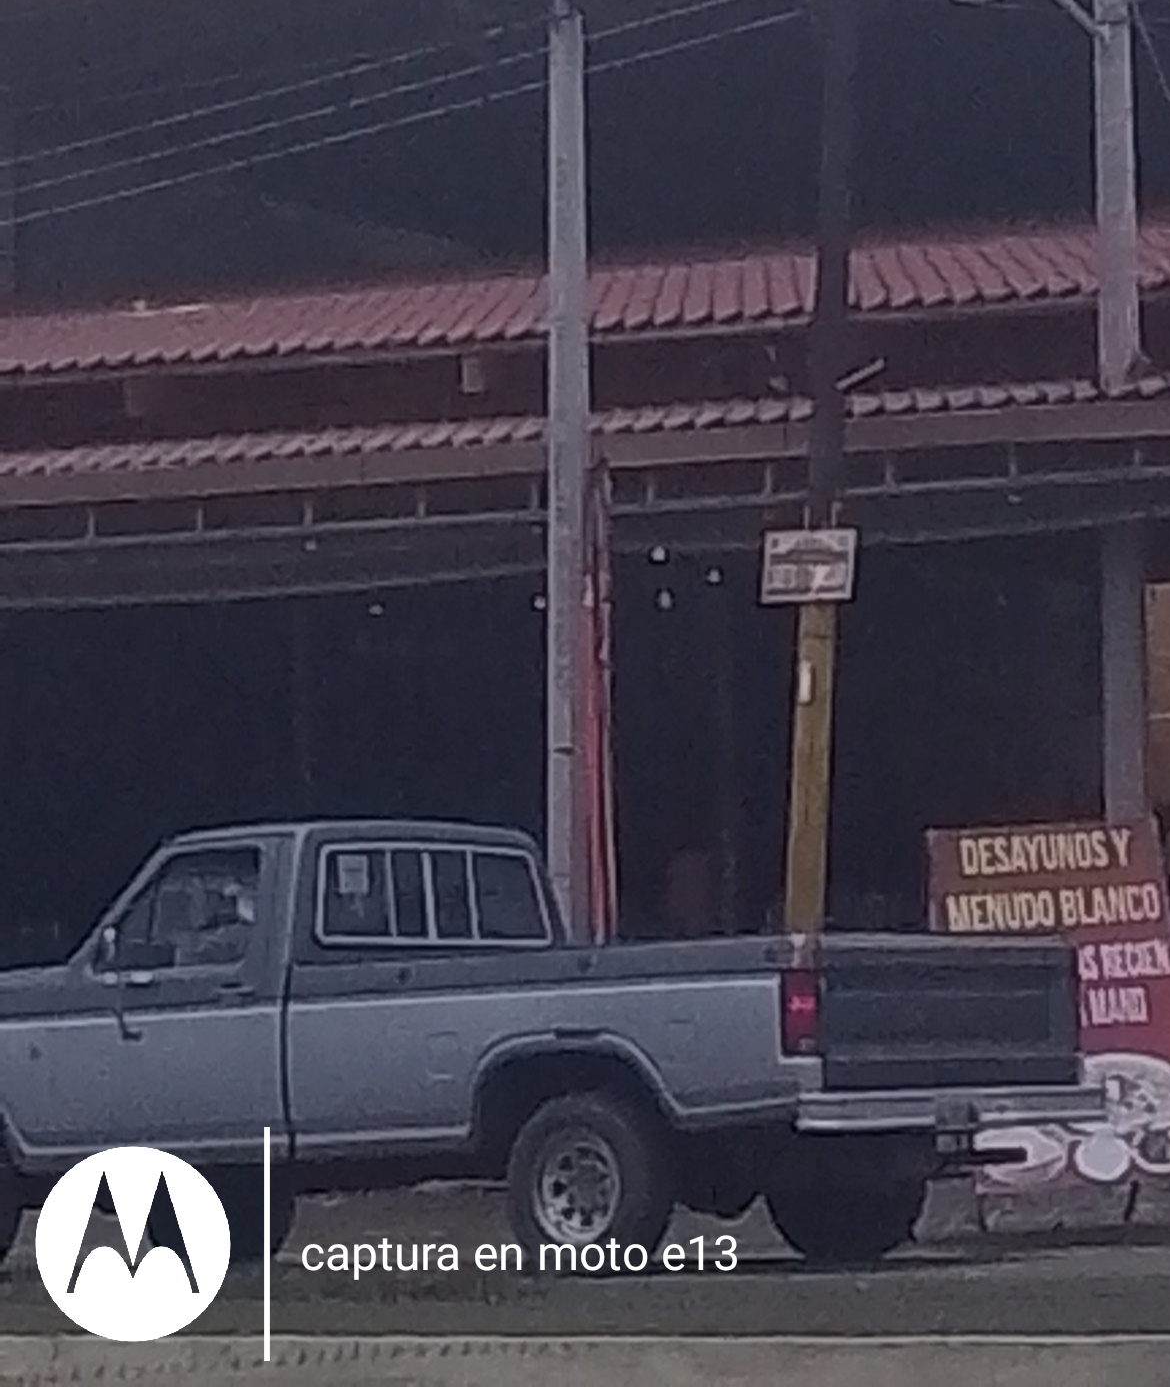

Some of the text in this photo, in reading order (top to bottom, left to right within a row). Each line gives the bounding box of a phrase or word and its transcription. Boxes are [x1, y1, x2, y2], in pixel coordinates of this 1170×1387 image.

[959, 827, 1132, 876] DESAYUNOS Y
[946, 882, 1162, 932] MENUDO BLANCO
